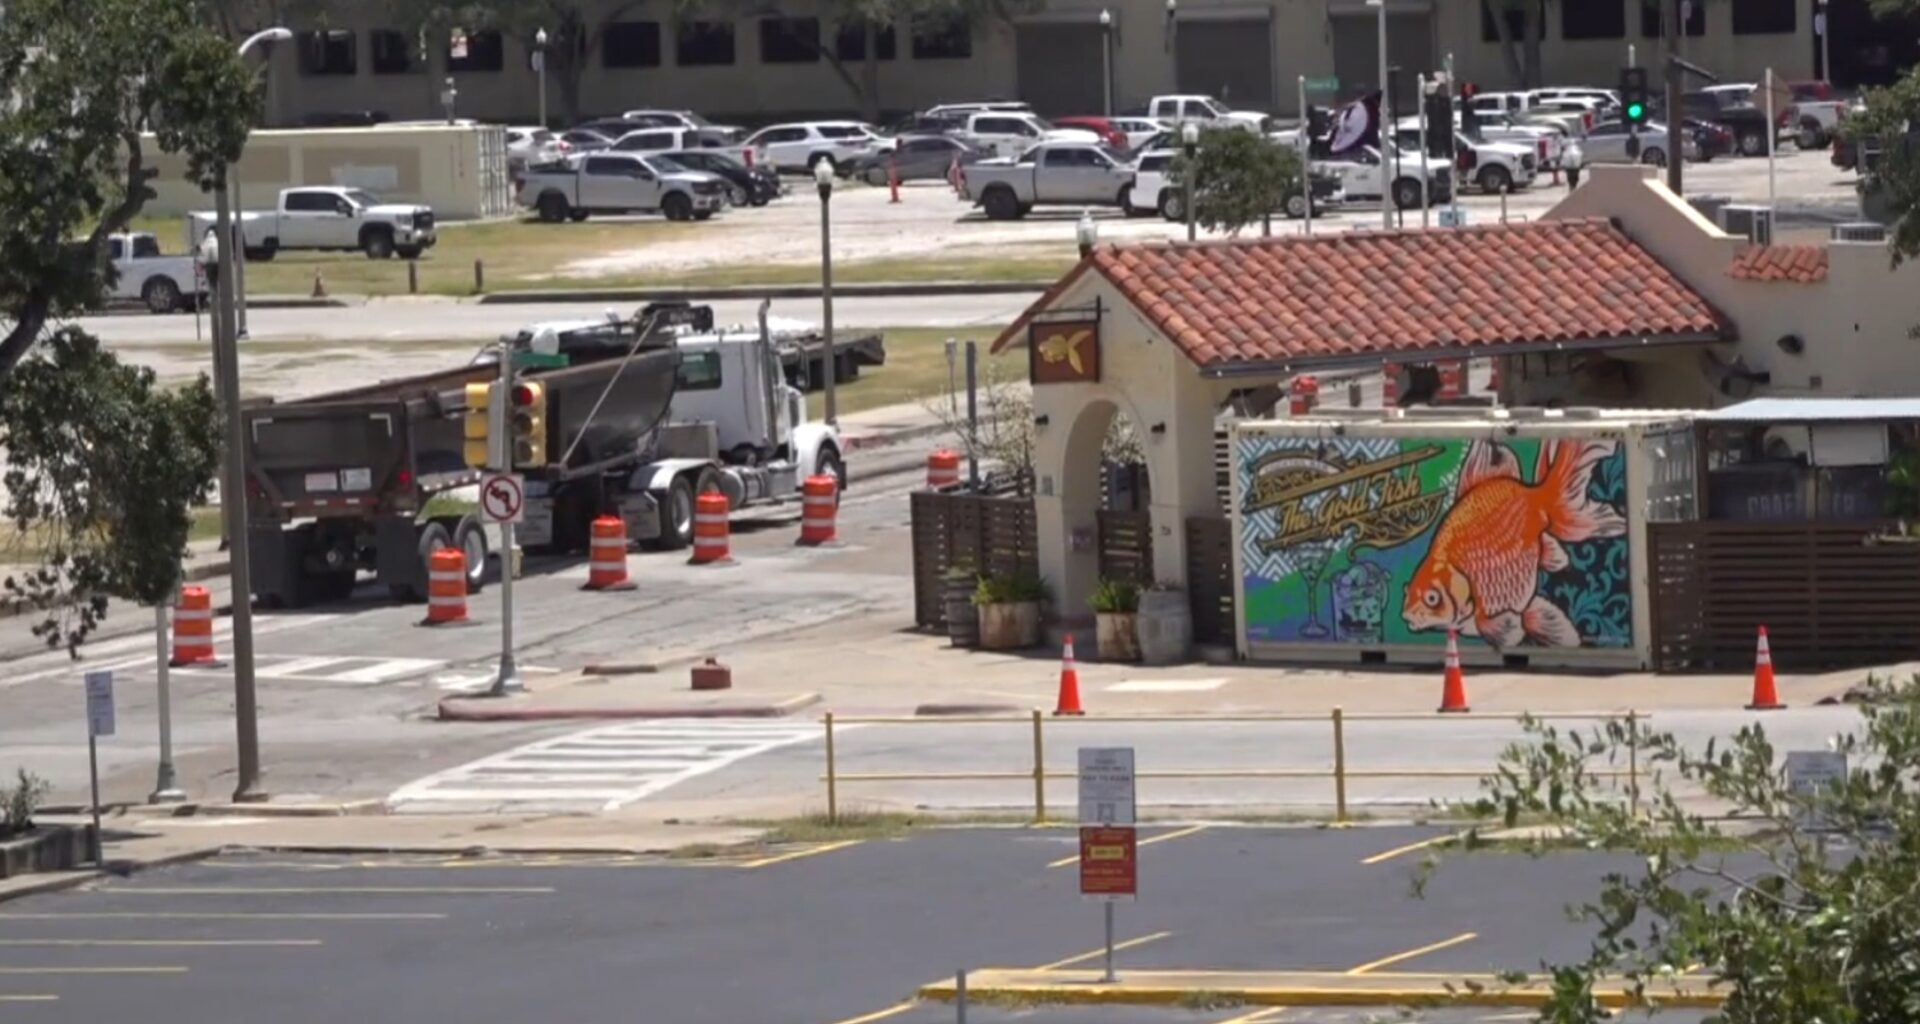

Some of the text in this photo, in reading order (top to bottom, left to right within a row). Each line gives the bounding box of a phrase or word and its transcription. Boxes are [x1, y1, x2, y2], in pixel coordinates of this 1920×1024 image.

[1279, 499, 1312, 535] The
[1317, 477, 1369, 533] Gold
[1370, 463, 1421, 508] Fish
